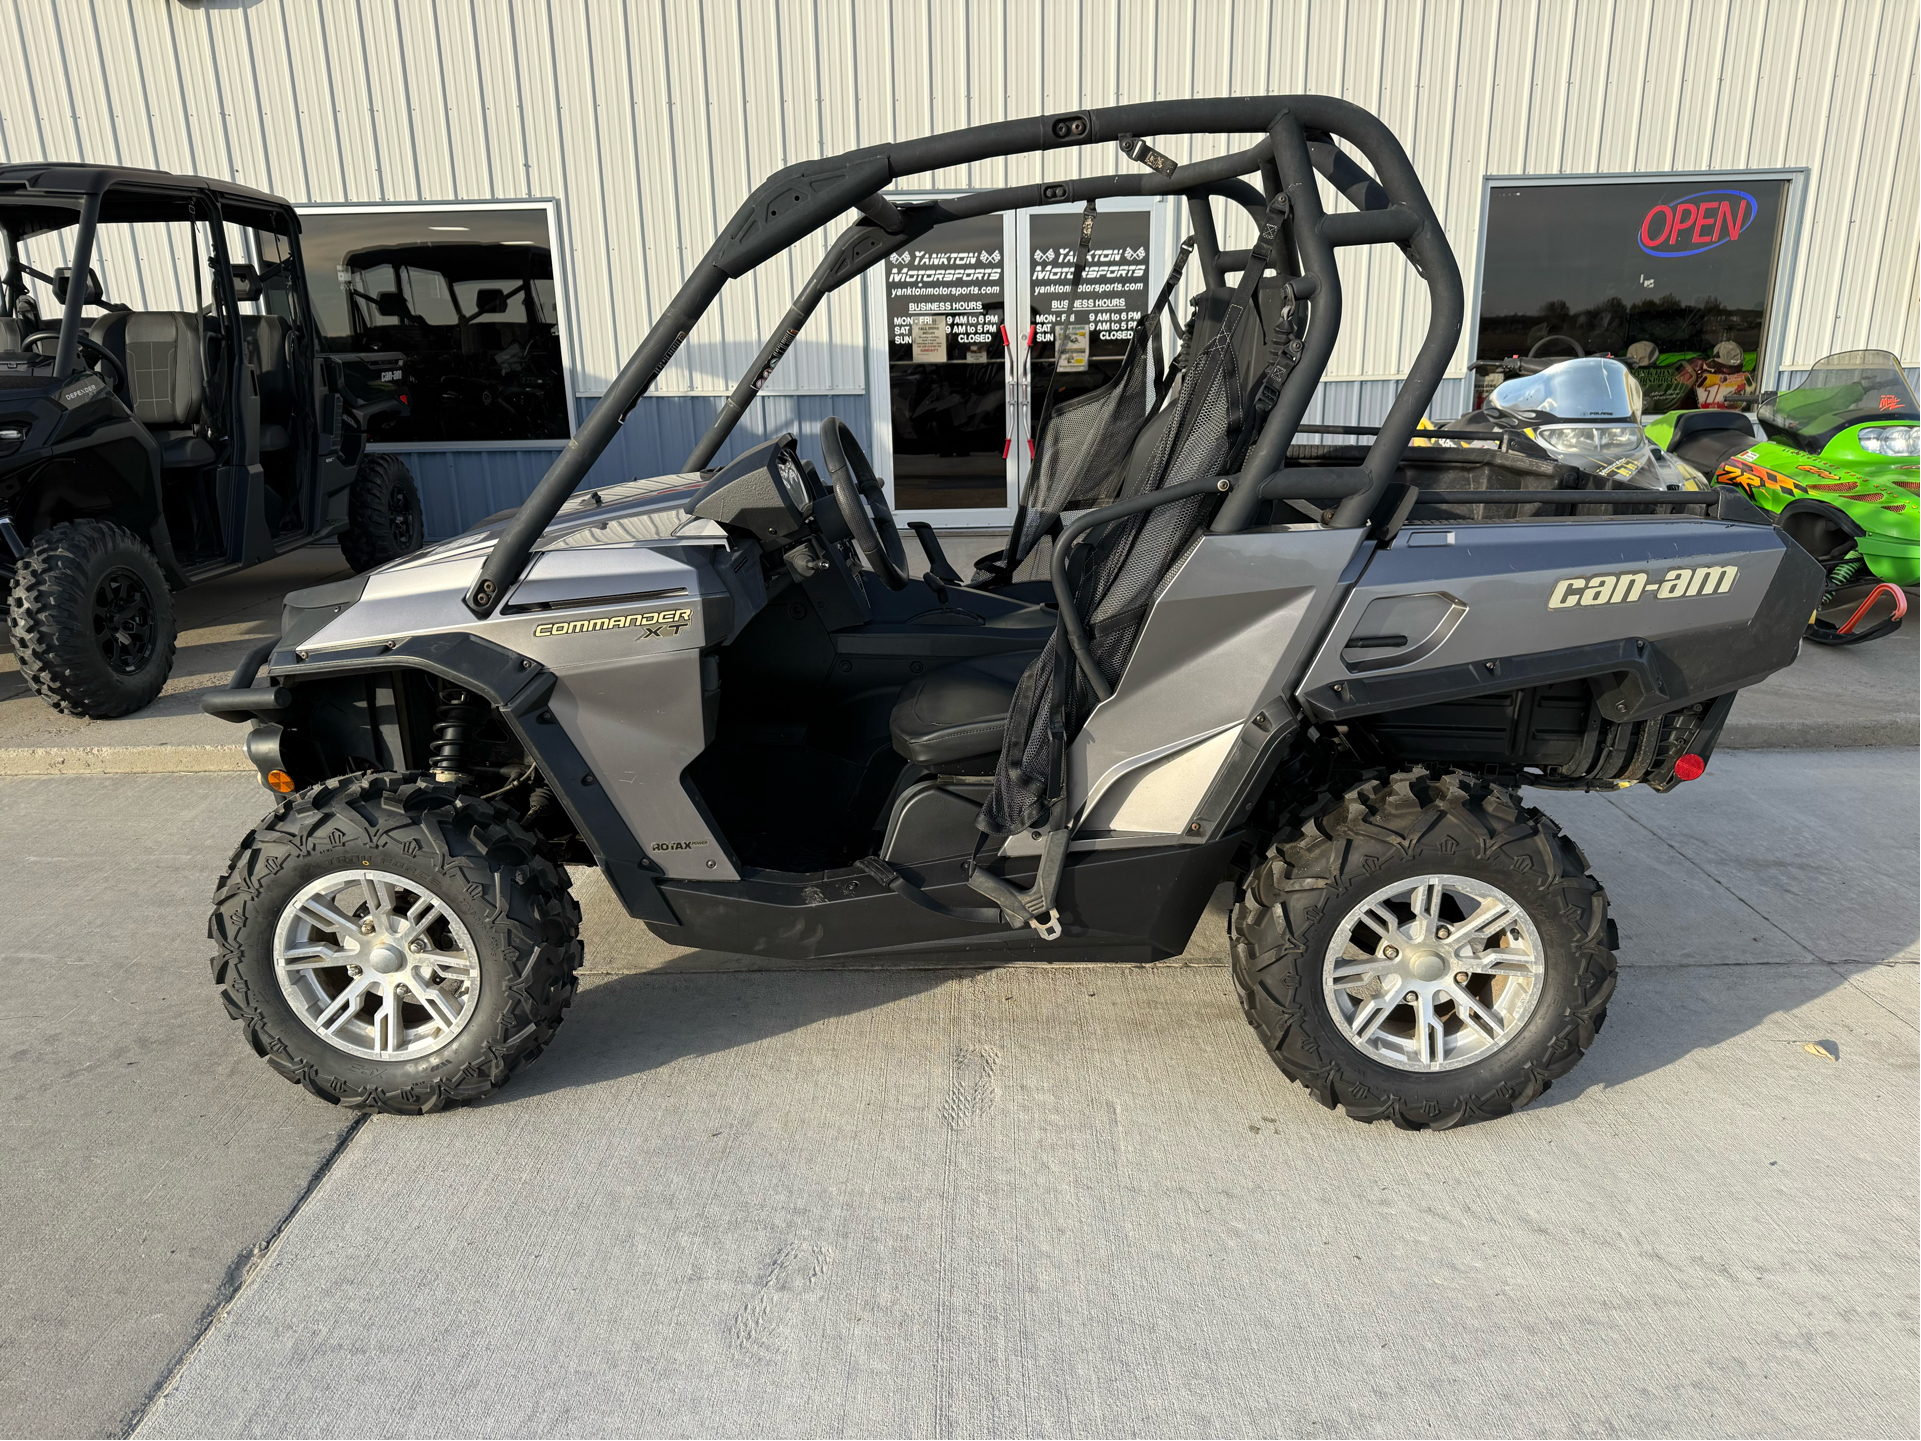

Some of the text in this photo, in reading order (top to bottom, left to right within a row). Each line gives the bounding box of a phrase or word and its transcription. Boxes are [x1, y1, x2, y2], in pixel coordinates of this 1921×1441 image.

[1641, 199, 1748, 247] OPEN
[914, 251, 978, 265] YANKTON
[889, 268, 1002, 282] MOTORSPORTS
[891, 285, 1000, 298] yanktonmotorsports.com
[1034, 282, 1144, 296] yanktonotorsports.com
[909, 301, 983, 311] BUSINESS HOURS
[1051, 298, 1126, 308] BUSNESS HOURS
[894, 317, 913, 325] MON
[919, 316, 933, 325] FRI
[946, 316, 953, 324] 9
[954, 316, 968, 324] AM
[968, 315, 977, 323] to
[978, 315, 985, 323] 6
[985, 315, 998, 323] PM
[1036, 314, 1056, 323] MON
[1089, 313, 1095, 321] 9
[1096, 312, 1110, 321] AM
[1111, 312, 1120, 321] to
[1121, 312, 1127, 320] 6
[1128, 311, 1141, 320] PM
[894, 324, 997, 335] SAT 9 AM to 5 PM
[1036, 324, 1052, 332] SAT
[1089, 323, 1095, 331] 9
[1096, 322, 1110, 331] AM
[1111, 322, 1120, 330] to
[1121, 321, 1127, 330] 5
[894, 334, 992, 344] SUN CLOSED
[1036, 331, 1134, 342] SUN CLOSED
[381, 370, 402, 382] can-am
[65, 384, 97, 401] DEFENDER
[1548, 565, 1739, 609] can-am
[534, 608, 693, 637] COMMANDER
[642, 622, 689, 640] XT
[652, 841, 692, 851] ROTAX
